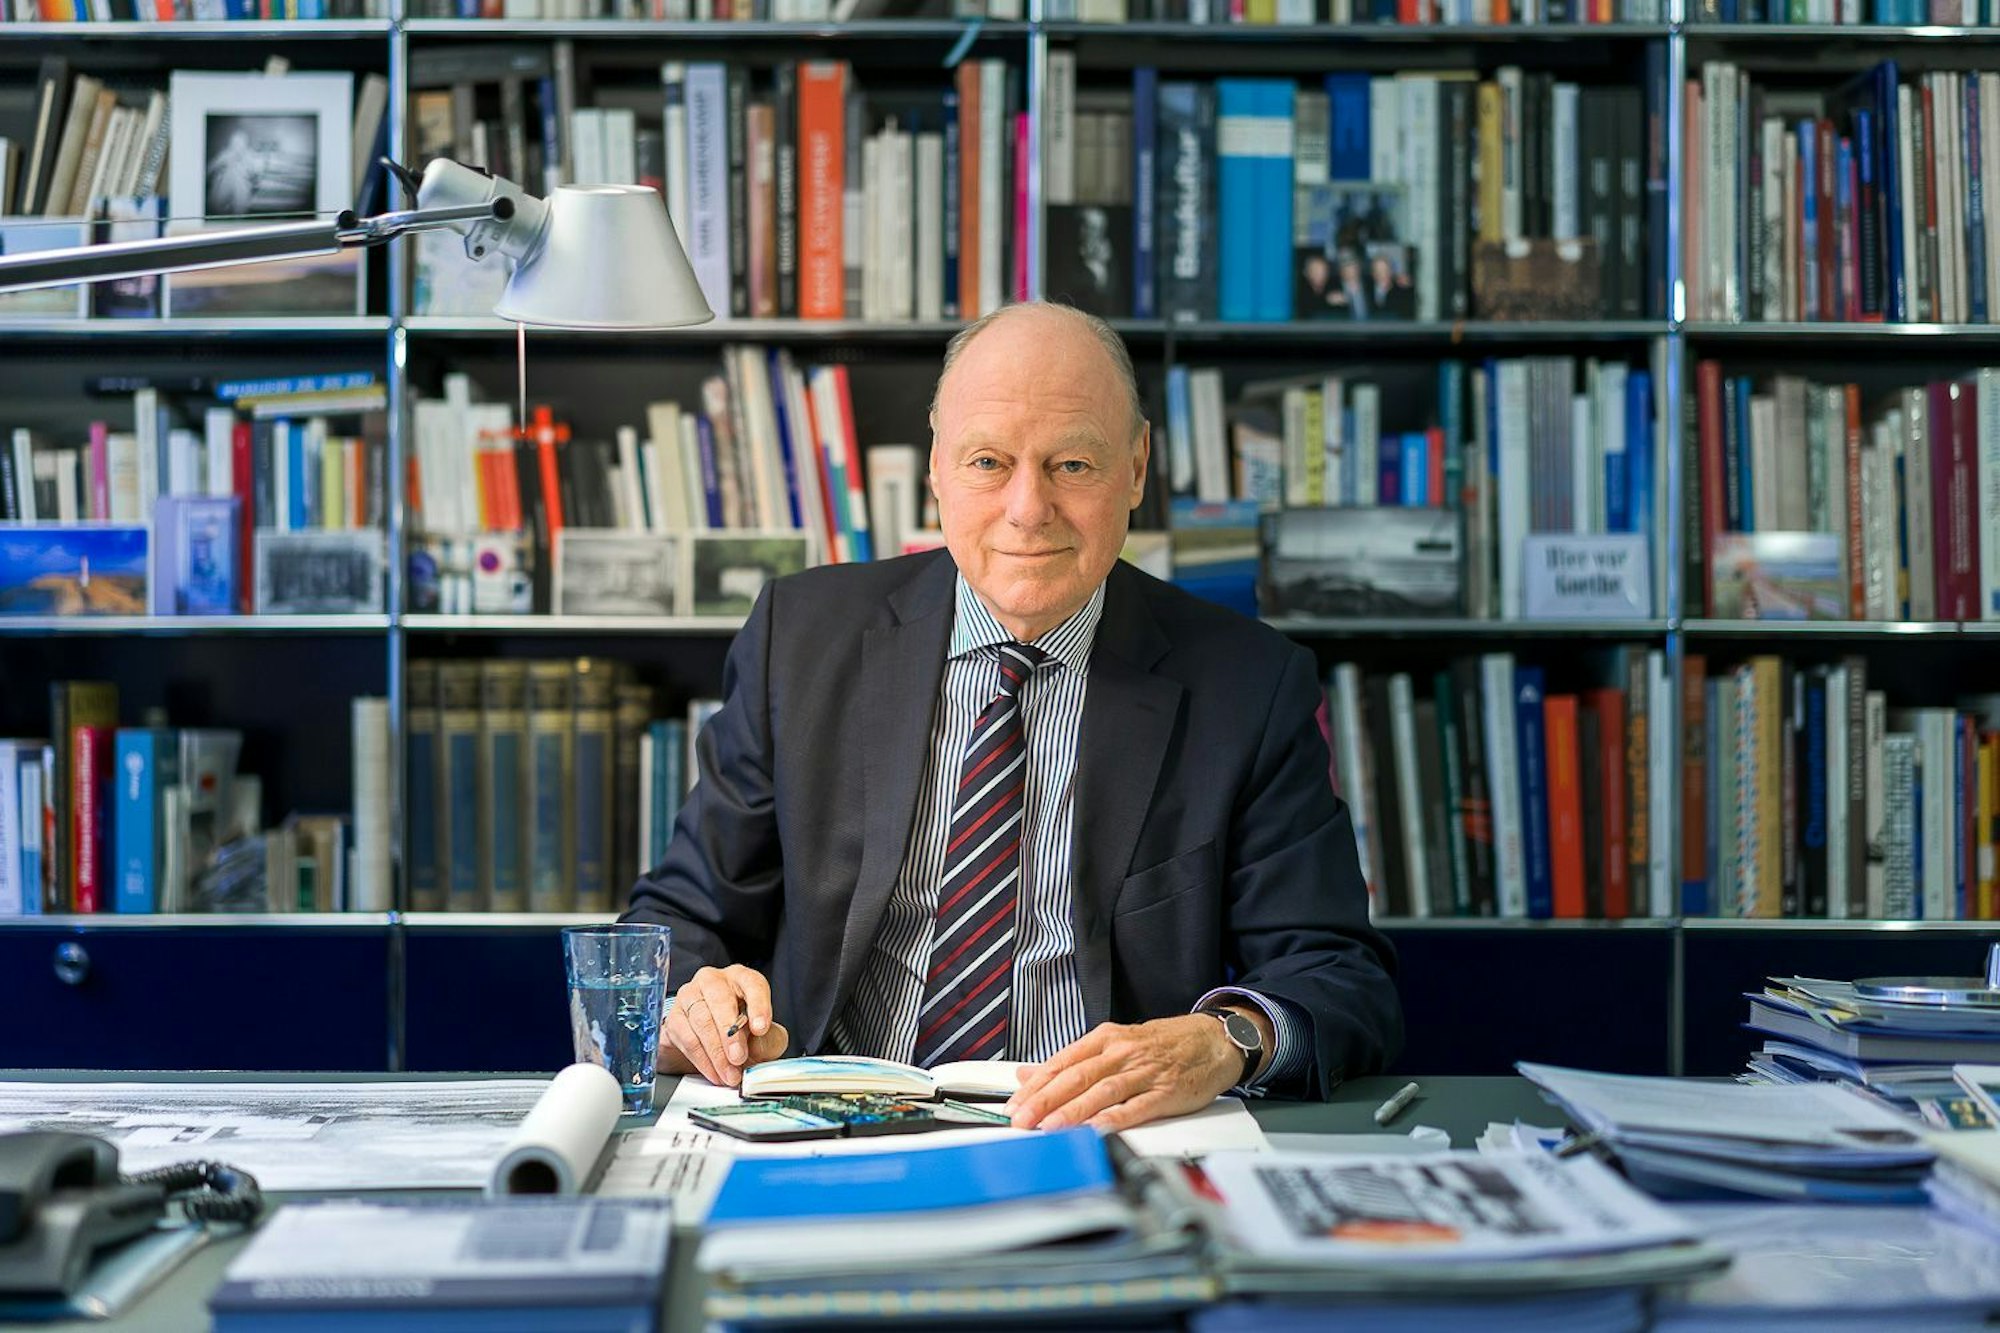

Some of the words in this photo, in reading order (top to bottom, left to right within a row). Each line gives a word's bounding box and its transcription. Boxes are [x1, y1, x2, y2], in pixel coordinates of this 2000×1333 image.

[1174, 127, 1199, 279] Baukultur
[1546, 546, 1587, 571] Hier
[1593, 550, 1627, 569] war
[1555, 574, 1621, 597] Goethe
